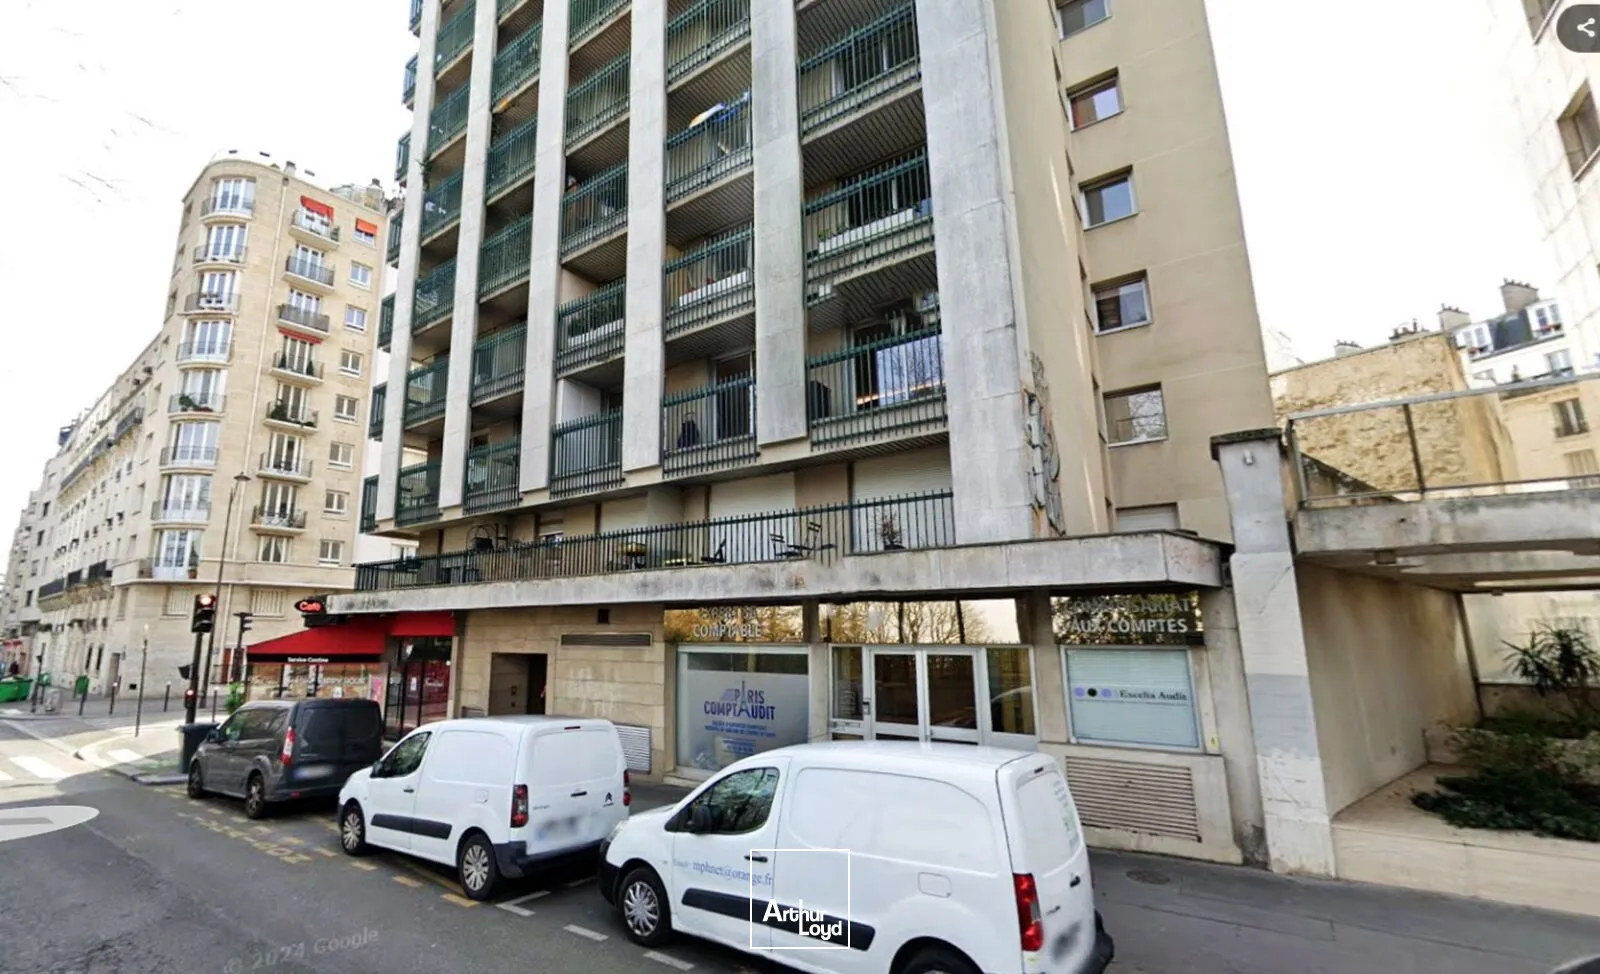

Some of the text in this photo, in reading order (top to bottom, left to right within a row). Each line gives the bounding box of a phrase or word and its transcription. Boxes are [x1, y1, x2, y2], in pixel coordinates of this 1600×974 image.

[692, 623, 762, 638] COMPTABLE
[1107, 618, 1189, 634] COMPTES
[703, 700, 776, 720] COMPTAUDIT
